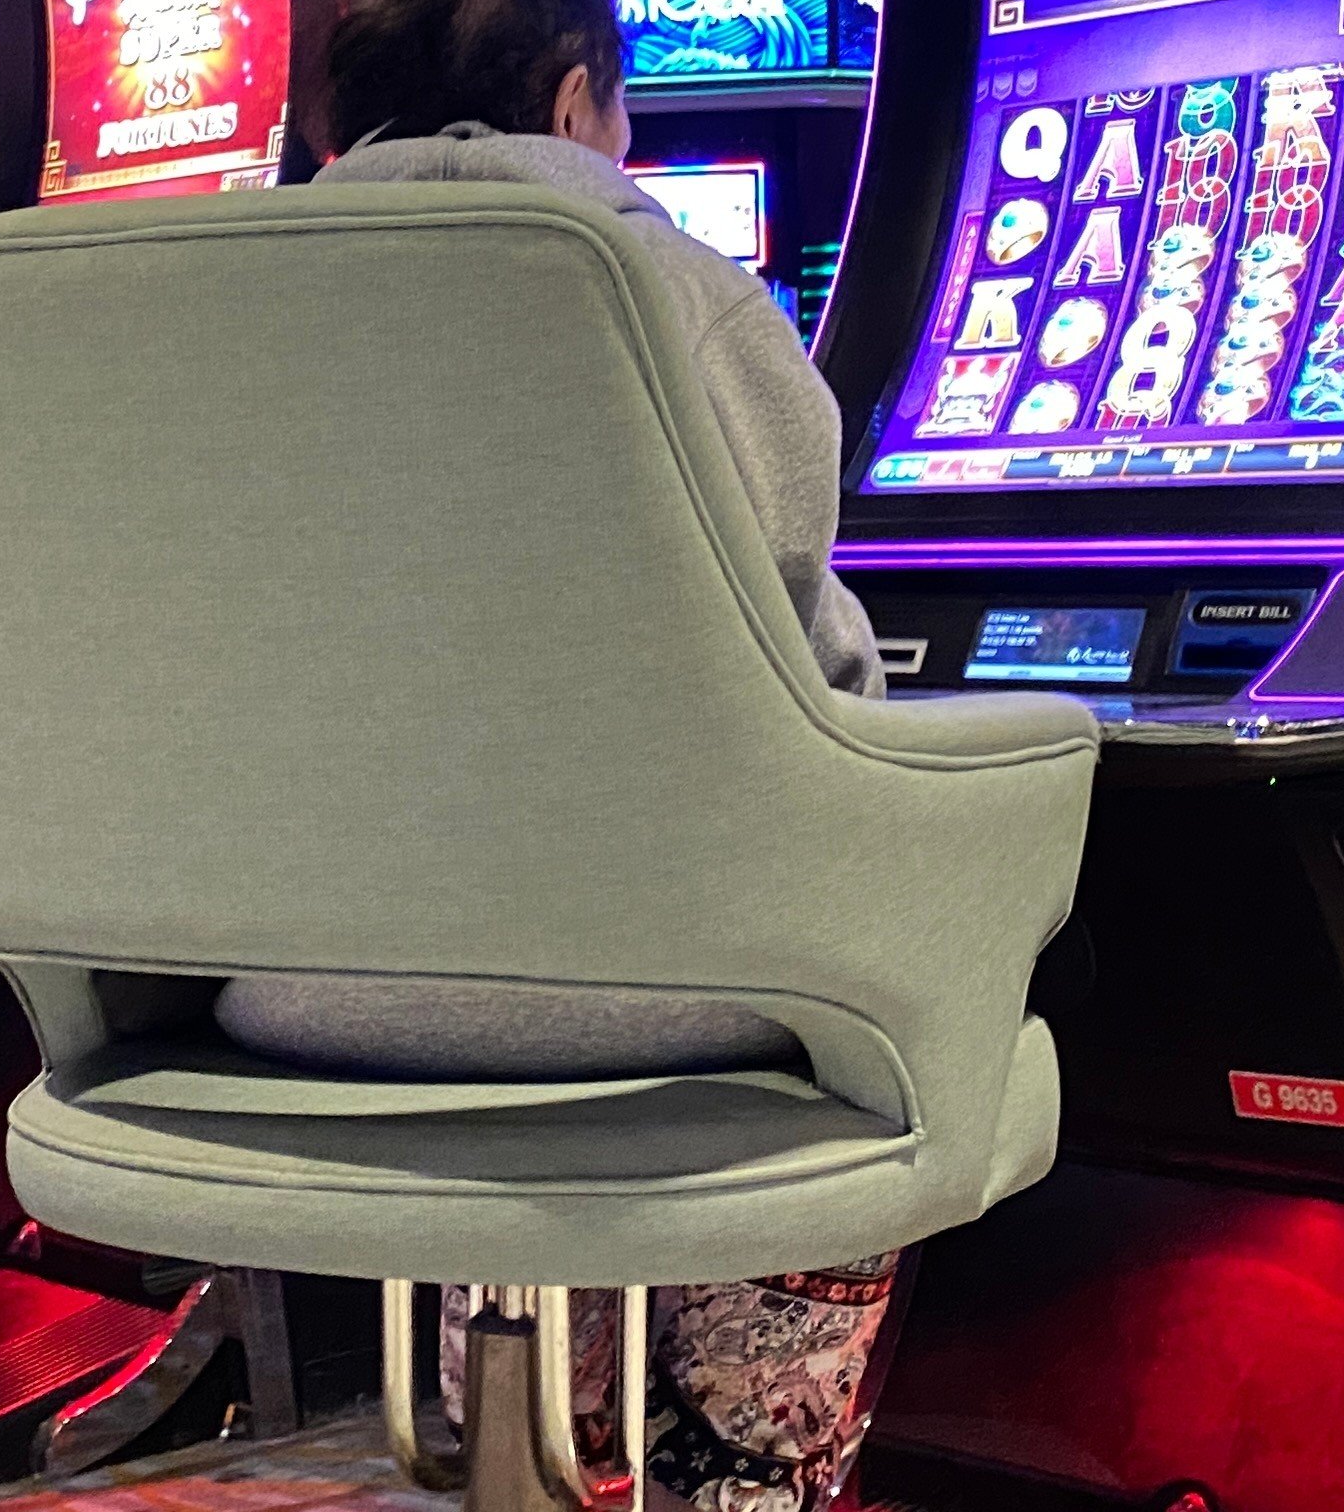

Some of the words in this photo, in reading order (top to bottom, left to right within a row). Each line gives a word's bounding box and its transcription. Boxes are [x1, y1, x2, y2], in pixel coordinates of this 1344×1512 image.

[145, 67, 194, 110] 88
[1200, 605, 1255, 619] INSERT
[1258, 605, 1291, 619] BILL
[1252, 1081, 1273, 1109] G
[1277, 1085, 1337, 1115] 9635
